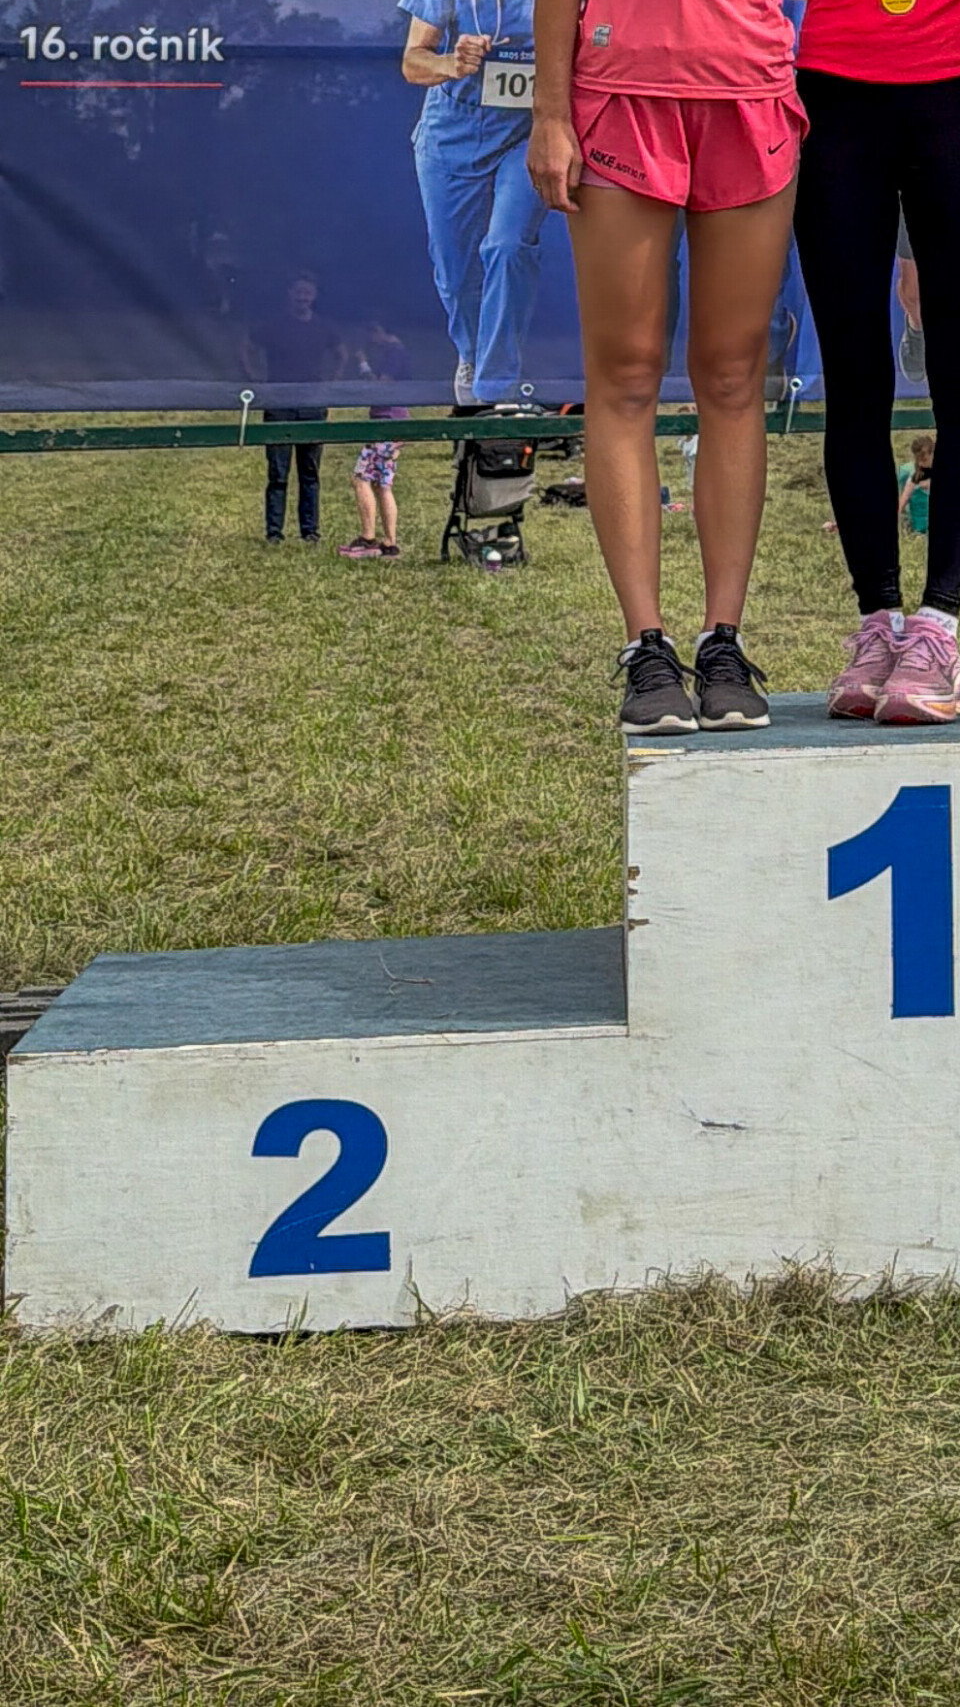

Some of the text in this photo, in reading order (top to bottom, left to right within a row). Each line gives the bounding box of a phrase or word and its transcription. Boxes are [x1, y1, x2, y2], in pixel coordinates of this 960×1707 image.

[20, 26, 224, 61] 16. ročník
[828, 786, 955, 1018] 1
[249, 1099, 391, 1276] 2
